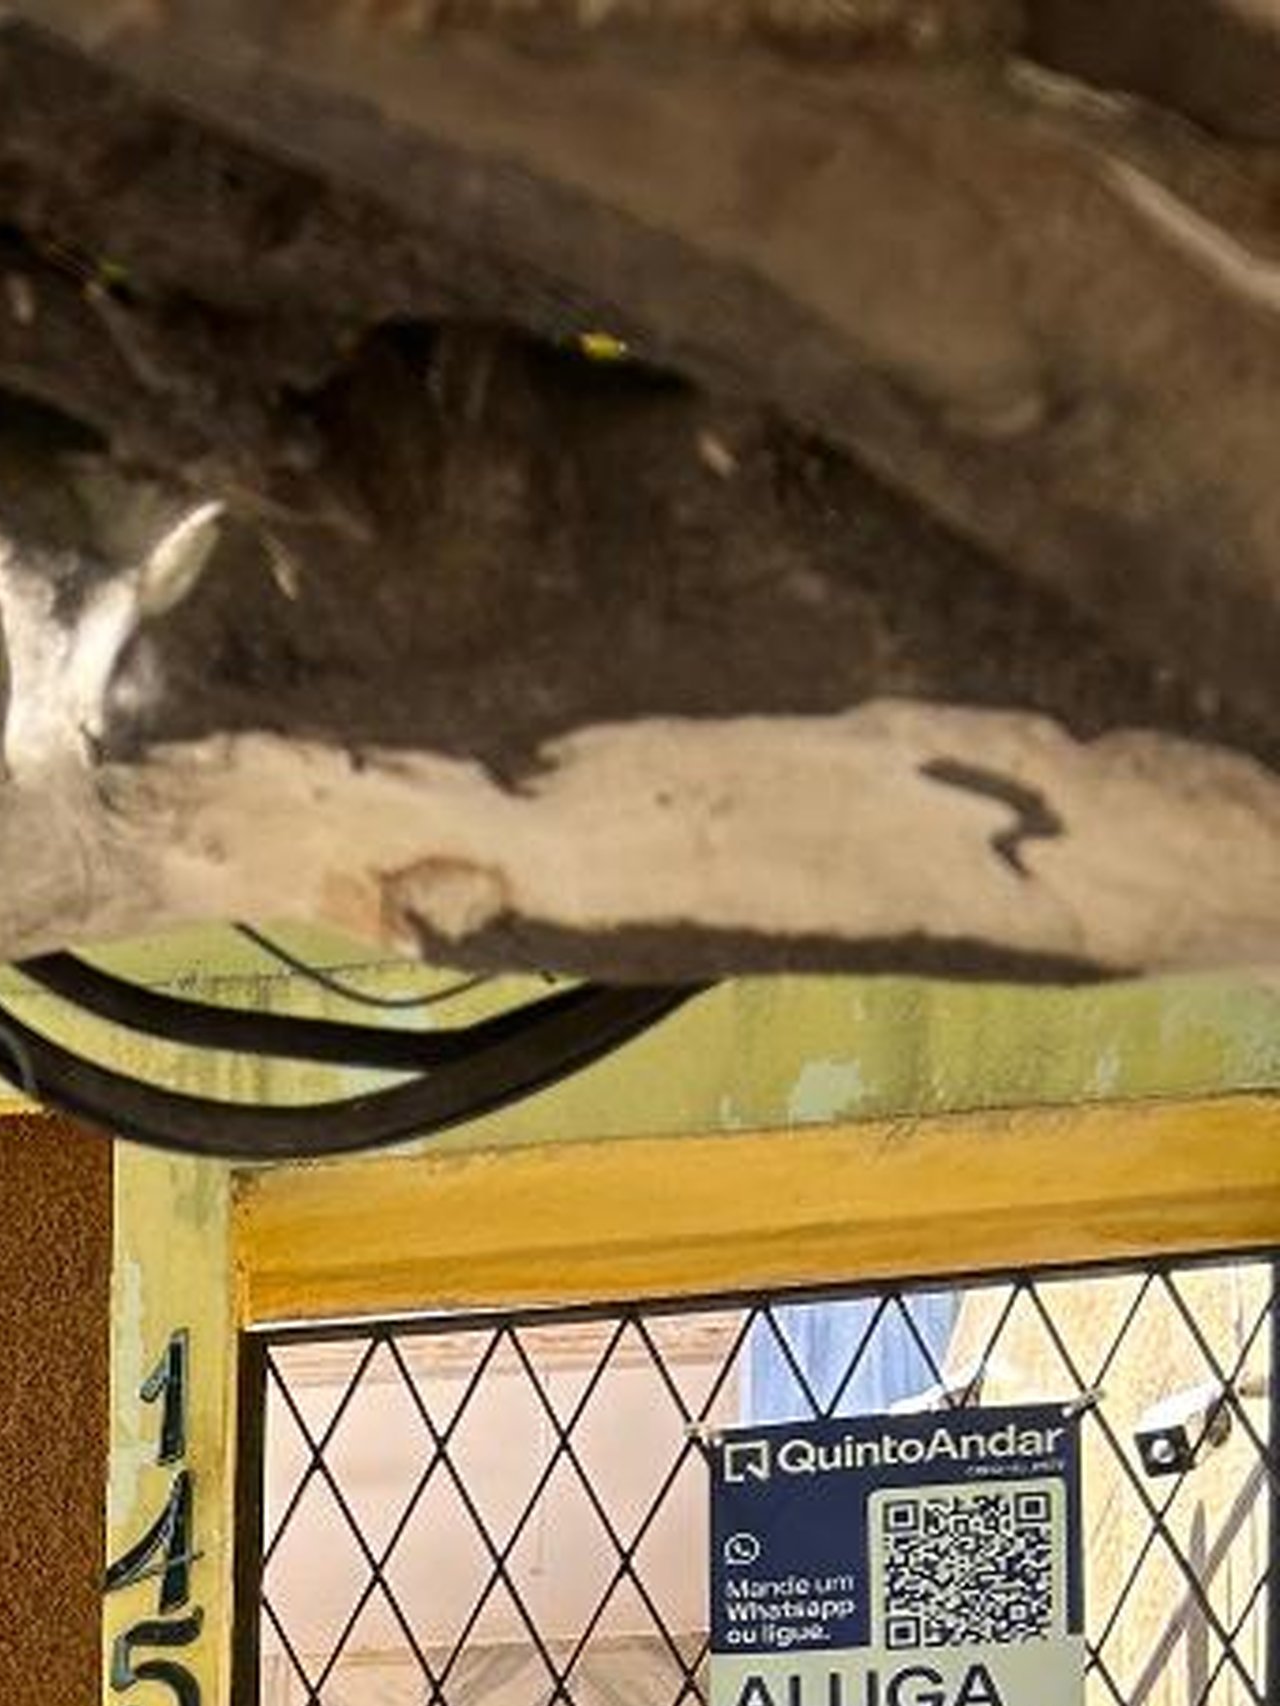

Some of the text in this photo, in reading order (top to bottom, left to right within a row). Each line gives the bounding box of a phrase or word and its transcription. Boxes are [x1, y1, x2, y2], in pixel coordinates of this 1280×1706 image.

[778, 1424, 1065, 1476] QuintoAndar
[725, 1575, 854, 1598] Mande um
[726, 1629, 757, 1644] ou
